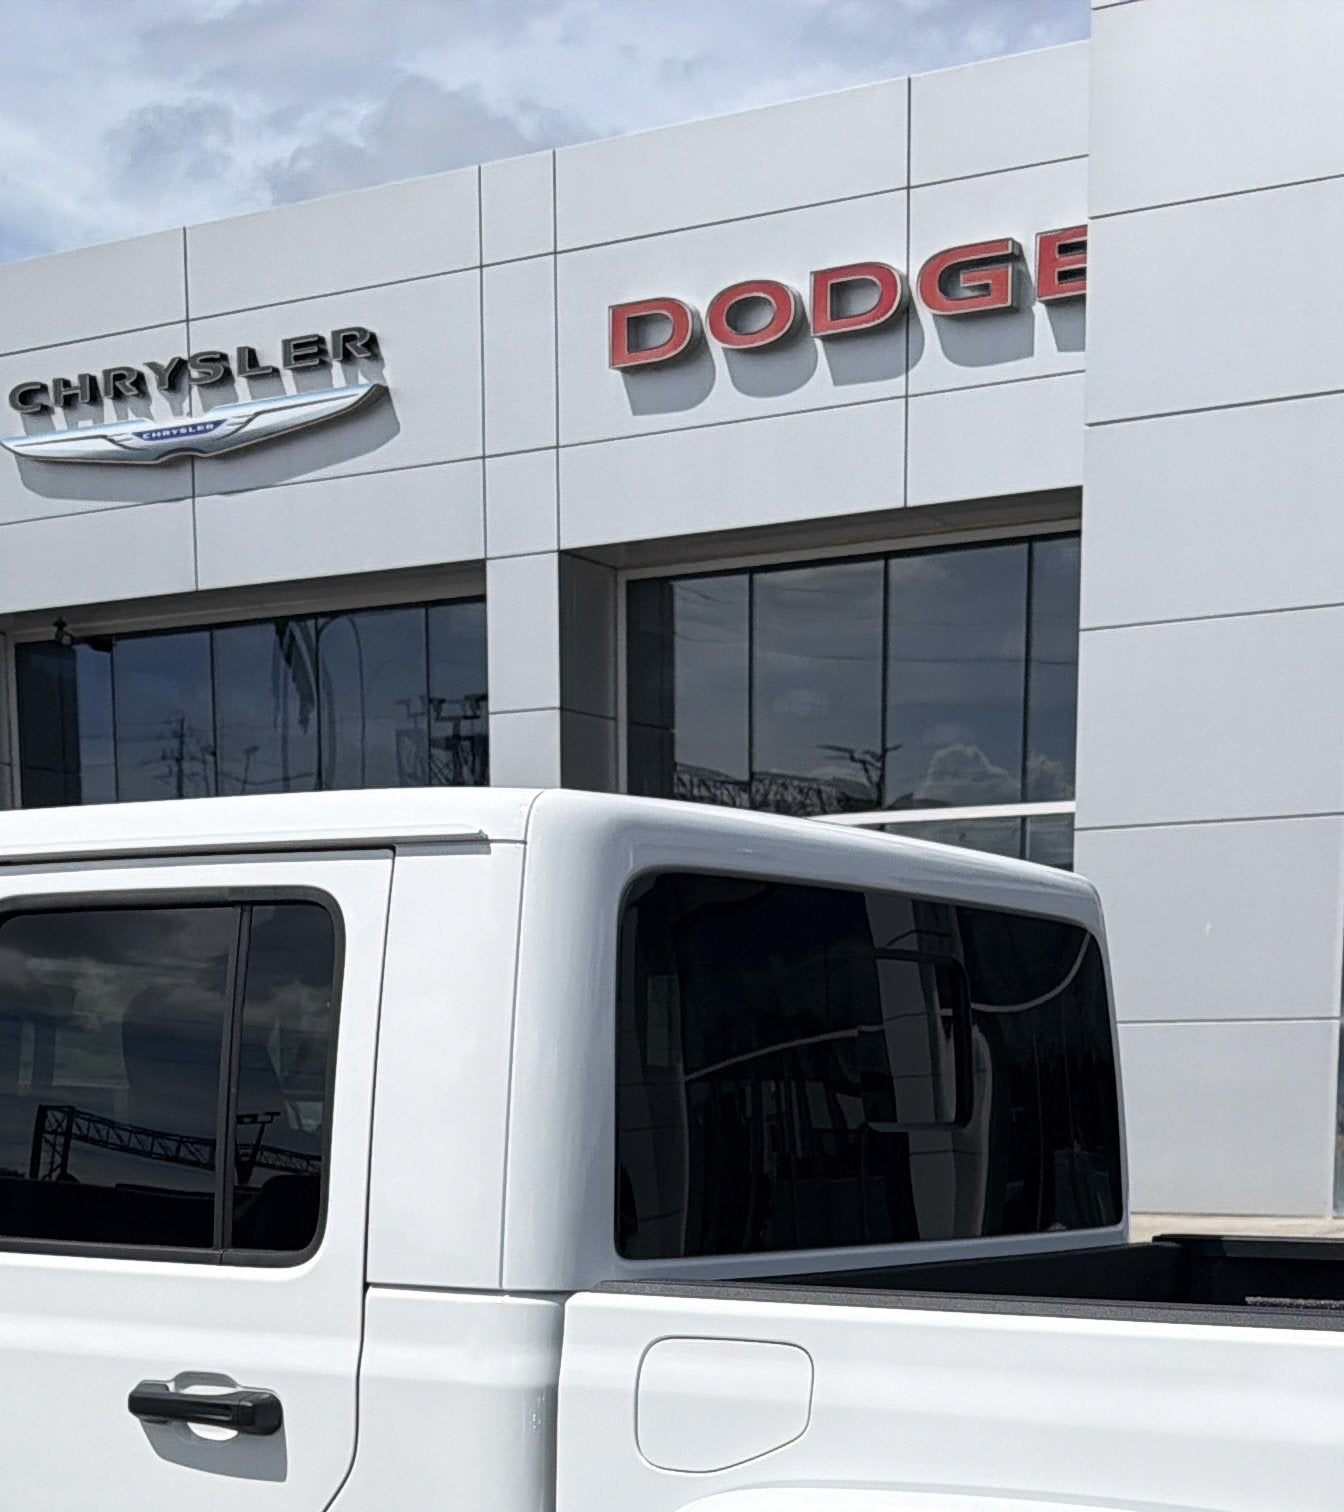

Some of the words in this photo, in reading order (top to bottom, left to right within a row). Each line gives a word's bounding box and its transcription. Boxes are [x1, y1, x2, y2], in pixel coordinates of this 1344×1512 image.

[608, 224, 1088, 369] DODGE
[9, 326, 381, 414] CHRYSLER
[143, 423, 215, 439] CHRYSLER
